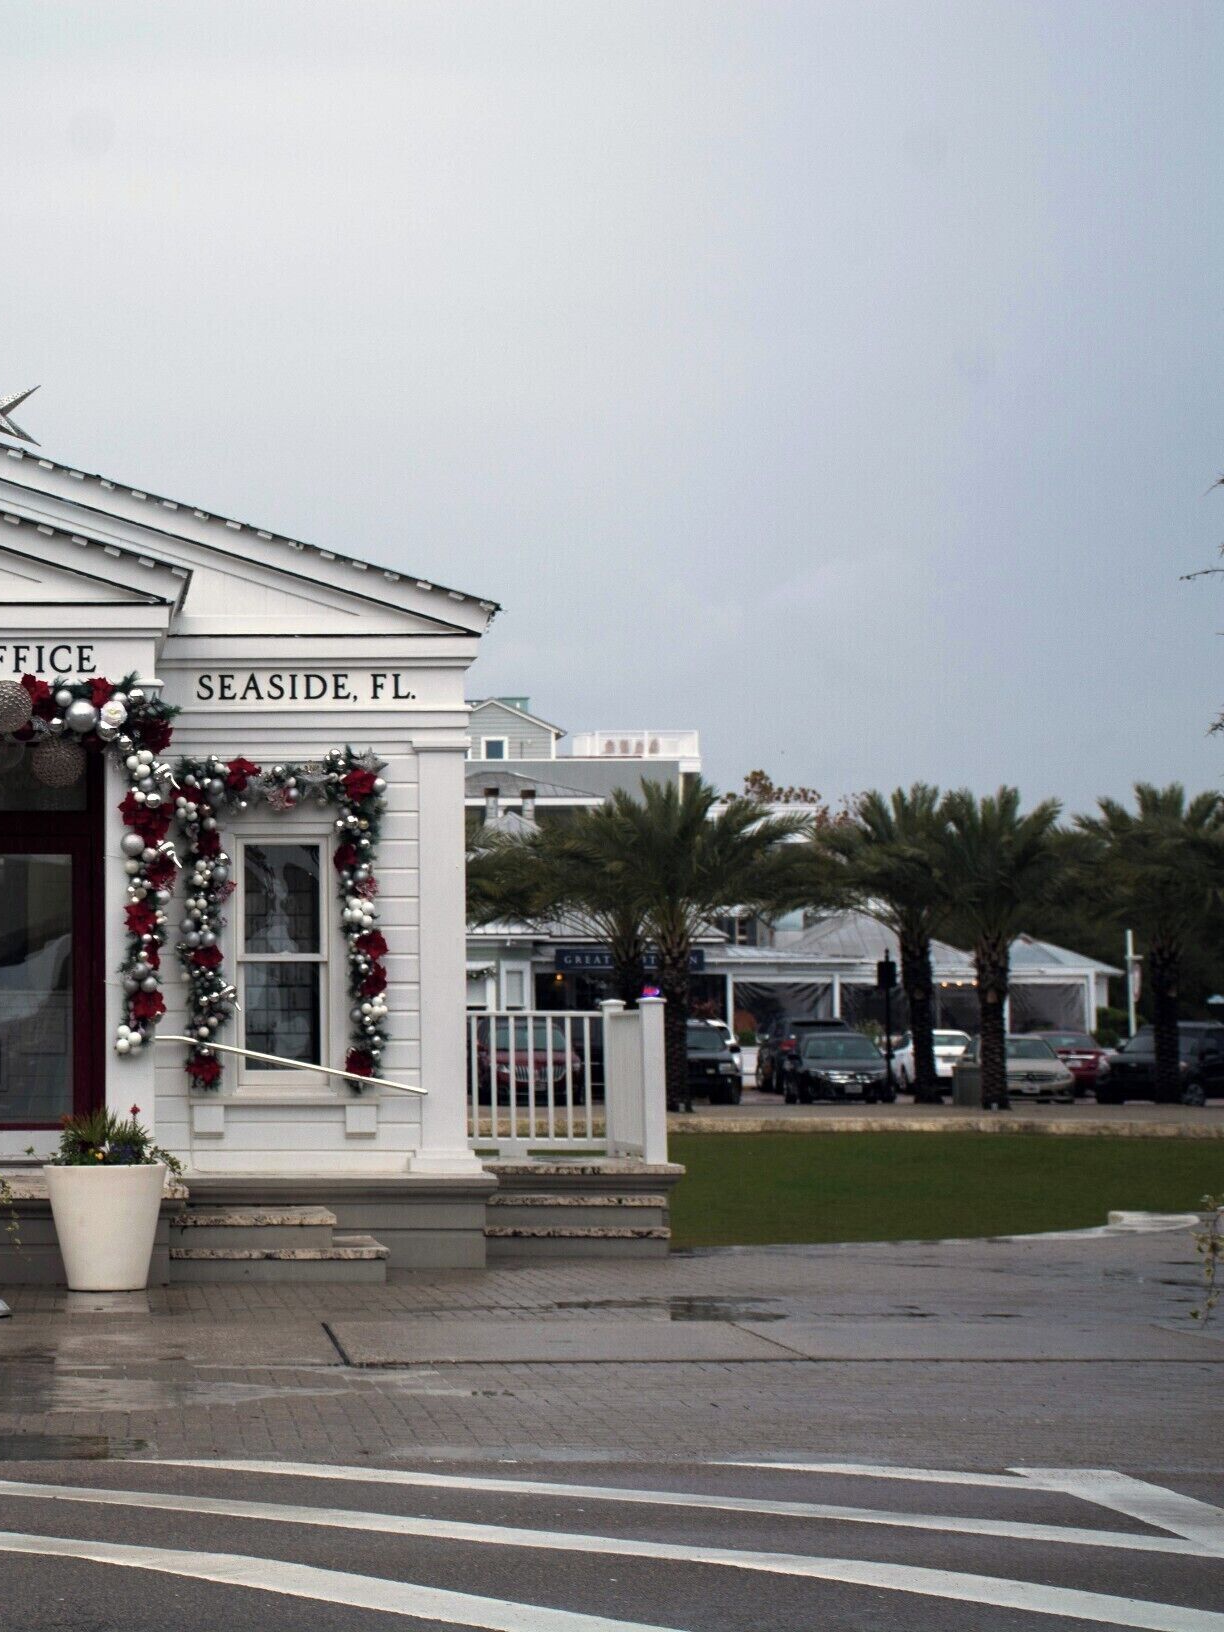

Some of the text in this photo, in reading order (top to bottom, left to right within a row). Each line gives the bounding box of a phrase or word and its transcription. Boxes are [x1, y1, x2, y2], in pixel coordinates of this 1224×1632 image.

[196, 673, 416, 702] SEASIDE, FL.
[563, 955, 612, 965] GREAT
